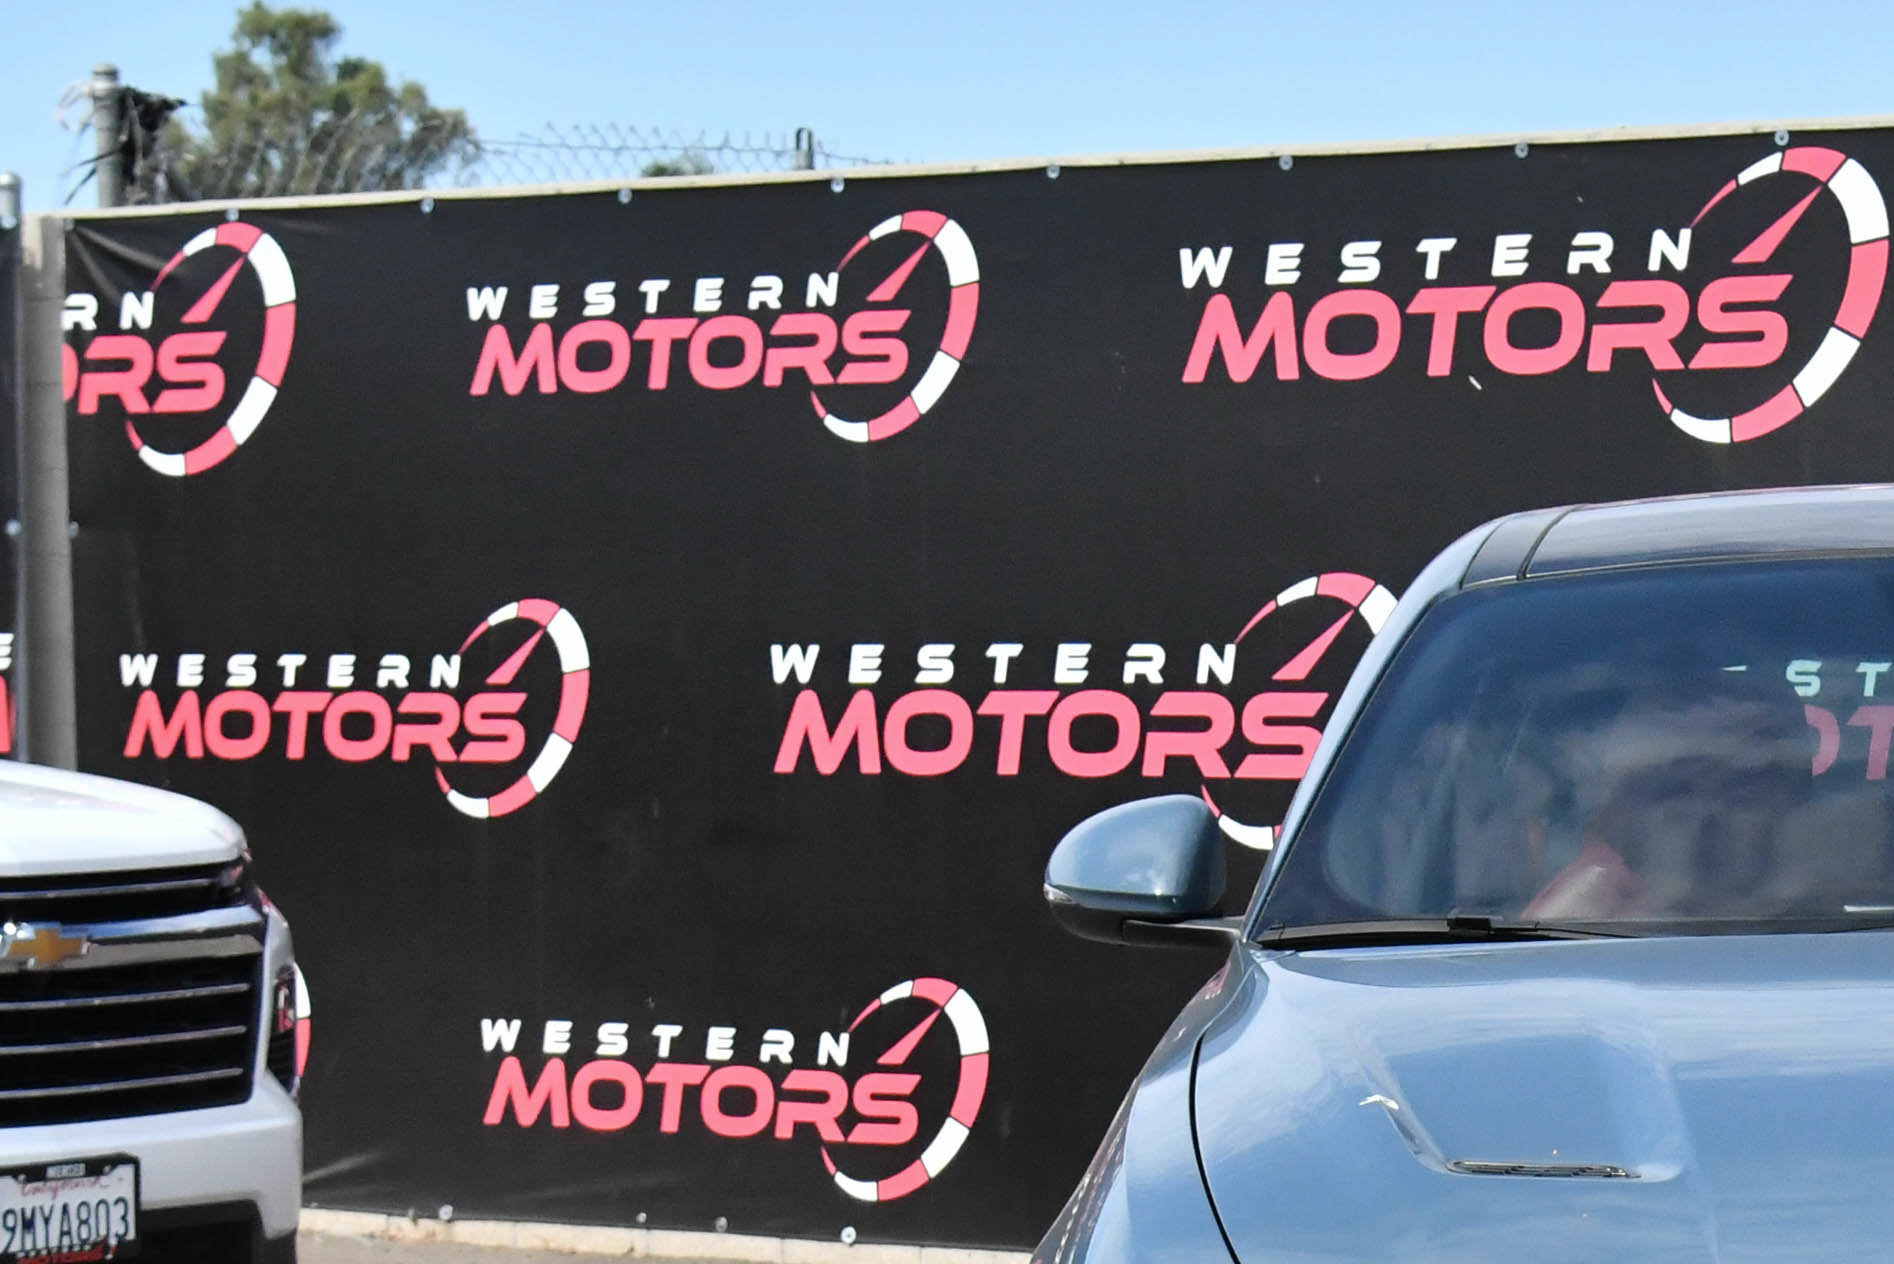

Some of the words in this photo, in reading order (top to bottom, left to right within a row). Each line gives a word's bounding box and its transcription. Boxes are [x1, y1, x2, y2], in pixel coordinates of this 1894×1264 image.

[1180, 228, 1691, 289] WESTERN
[467, 271, 839, 322] WESTERN
[470, 308, 911, 396] MOTORS
[1182, 274, 1793, 384] MOTORS
[120, 653, 461, 688] WESTERN
[771, 643, 1236, 684] WESTERN
[124, 689, 527, 763] MOTORS
[774, 689, 1329, 779] MOTORS
[481, 1018, 849, 1067] WESTERN
[483, 1056, 921, 1145] MOTORS
[1, 1196, 129, 1254] 9MYA803
